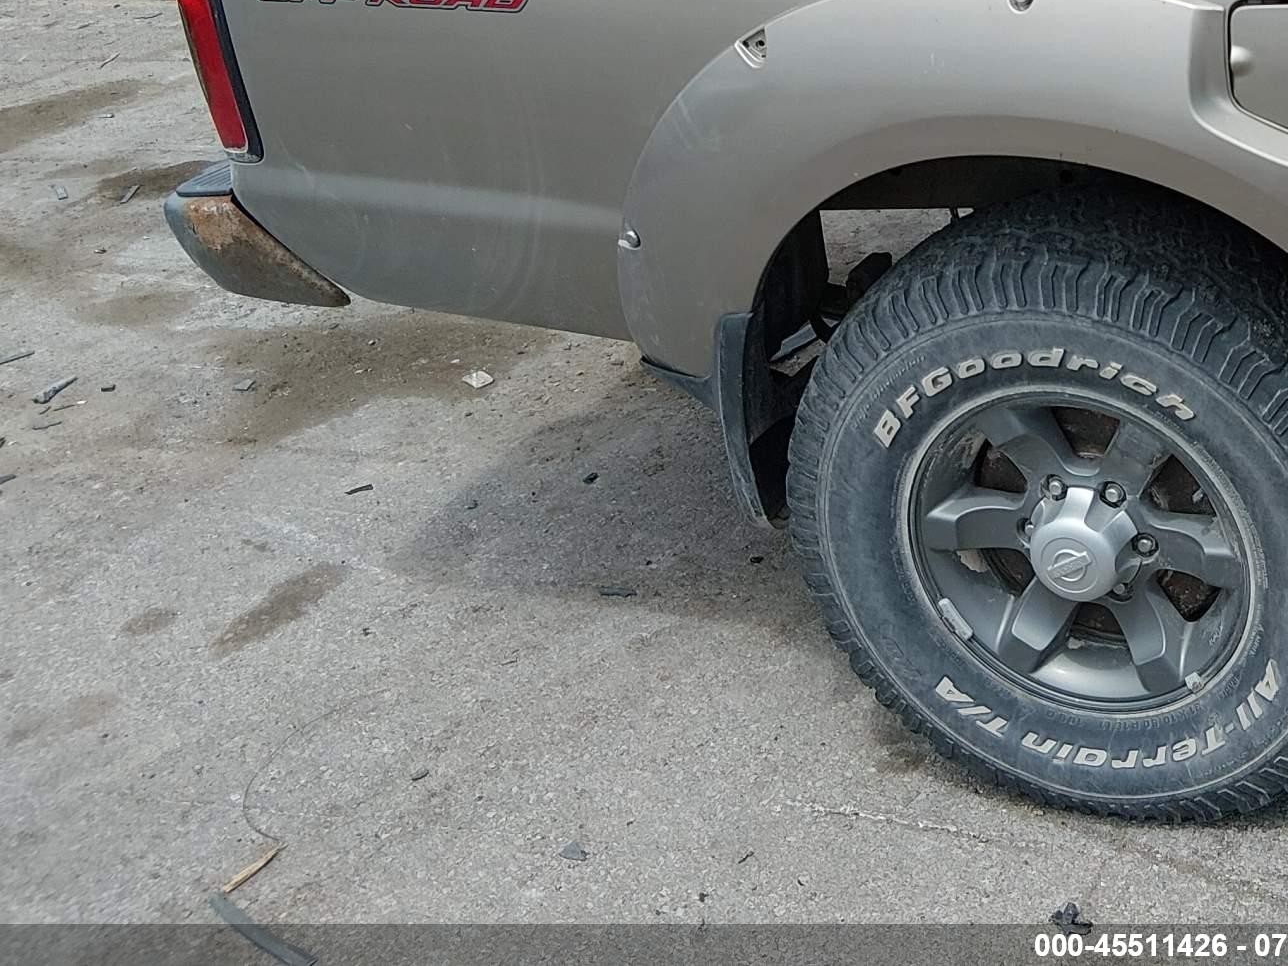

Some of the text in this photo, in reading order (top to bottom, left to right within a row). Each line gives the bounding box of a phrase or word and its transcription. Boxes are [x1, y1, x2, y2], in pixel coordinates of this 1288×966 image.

[873, 347, 1195, 448] BFGoodrich
[935, 676, 1007, 737] T/A
[1021, 659, 1279, 769] All-Terrain
